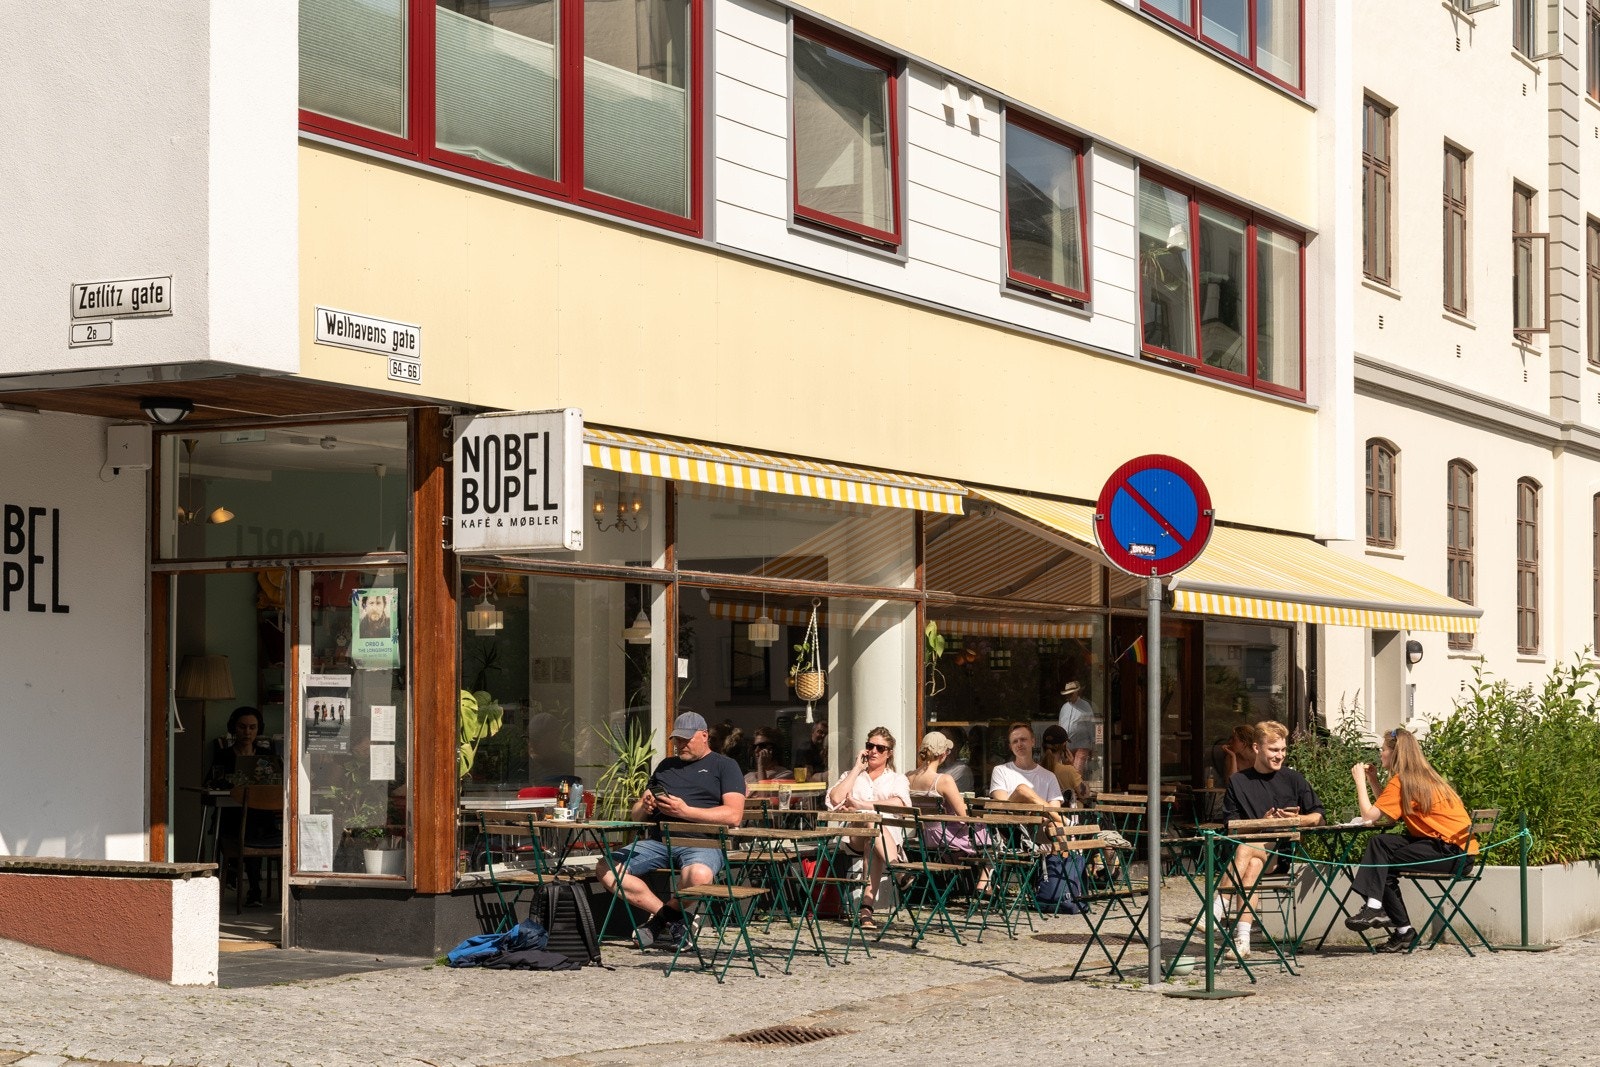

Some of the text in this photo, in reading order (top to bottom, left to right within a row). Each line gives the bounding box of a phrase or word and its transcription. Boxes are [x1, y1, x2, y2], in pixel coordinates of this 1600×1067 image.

[79, 282, 163, 310] Zetlitz gate
[325, 312, 415, 351] Welhavens gate
[461, 516, 559, 528] KAFÉ & MØBLER
